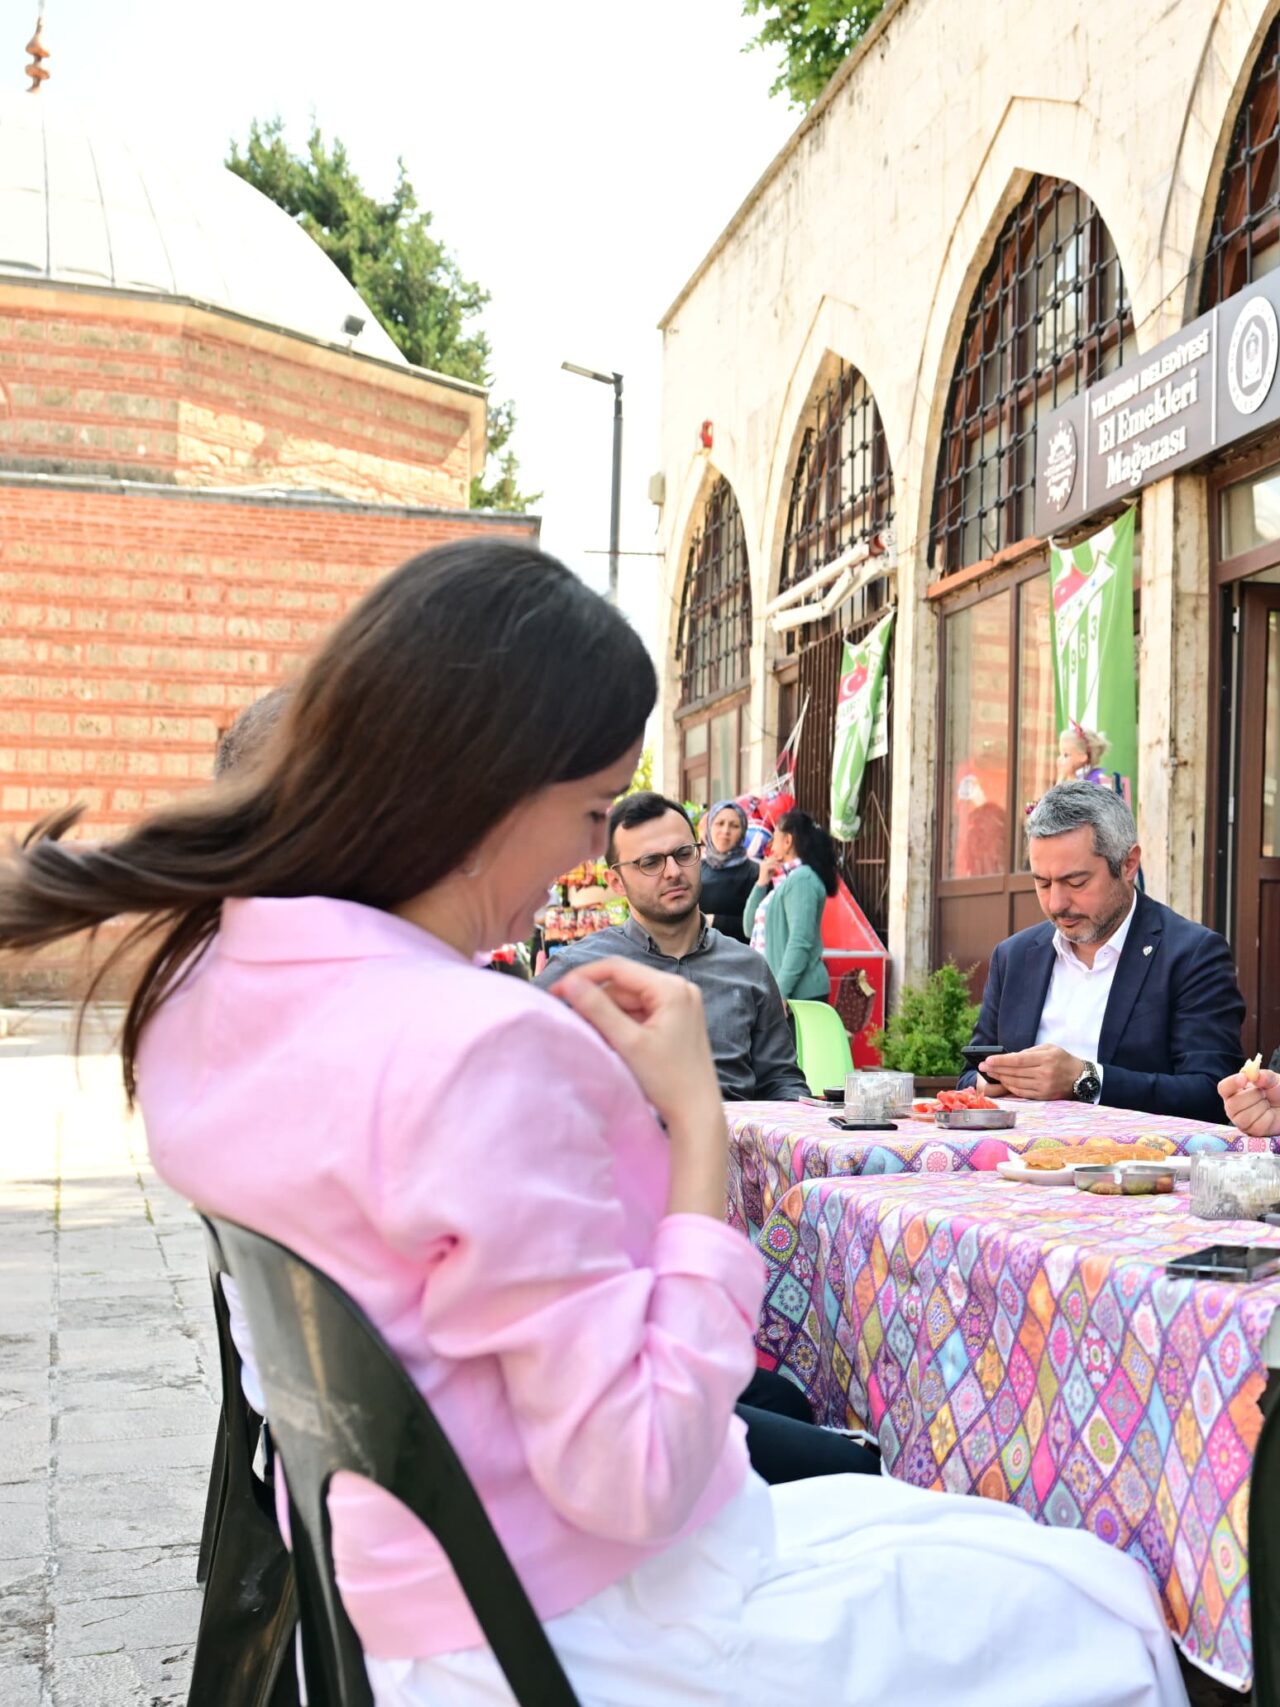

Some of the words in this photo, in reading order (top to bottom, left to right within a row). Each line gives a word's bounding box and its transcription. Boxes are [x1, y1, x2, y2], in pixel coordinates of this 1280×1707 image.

[1099, 413, 1116, 455] El
[1117, 368, 1199, 445] Emekleri
[1105, 425, 1187, 490] Mağazası
